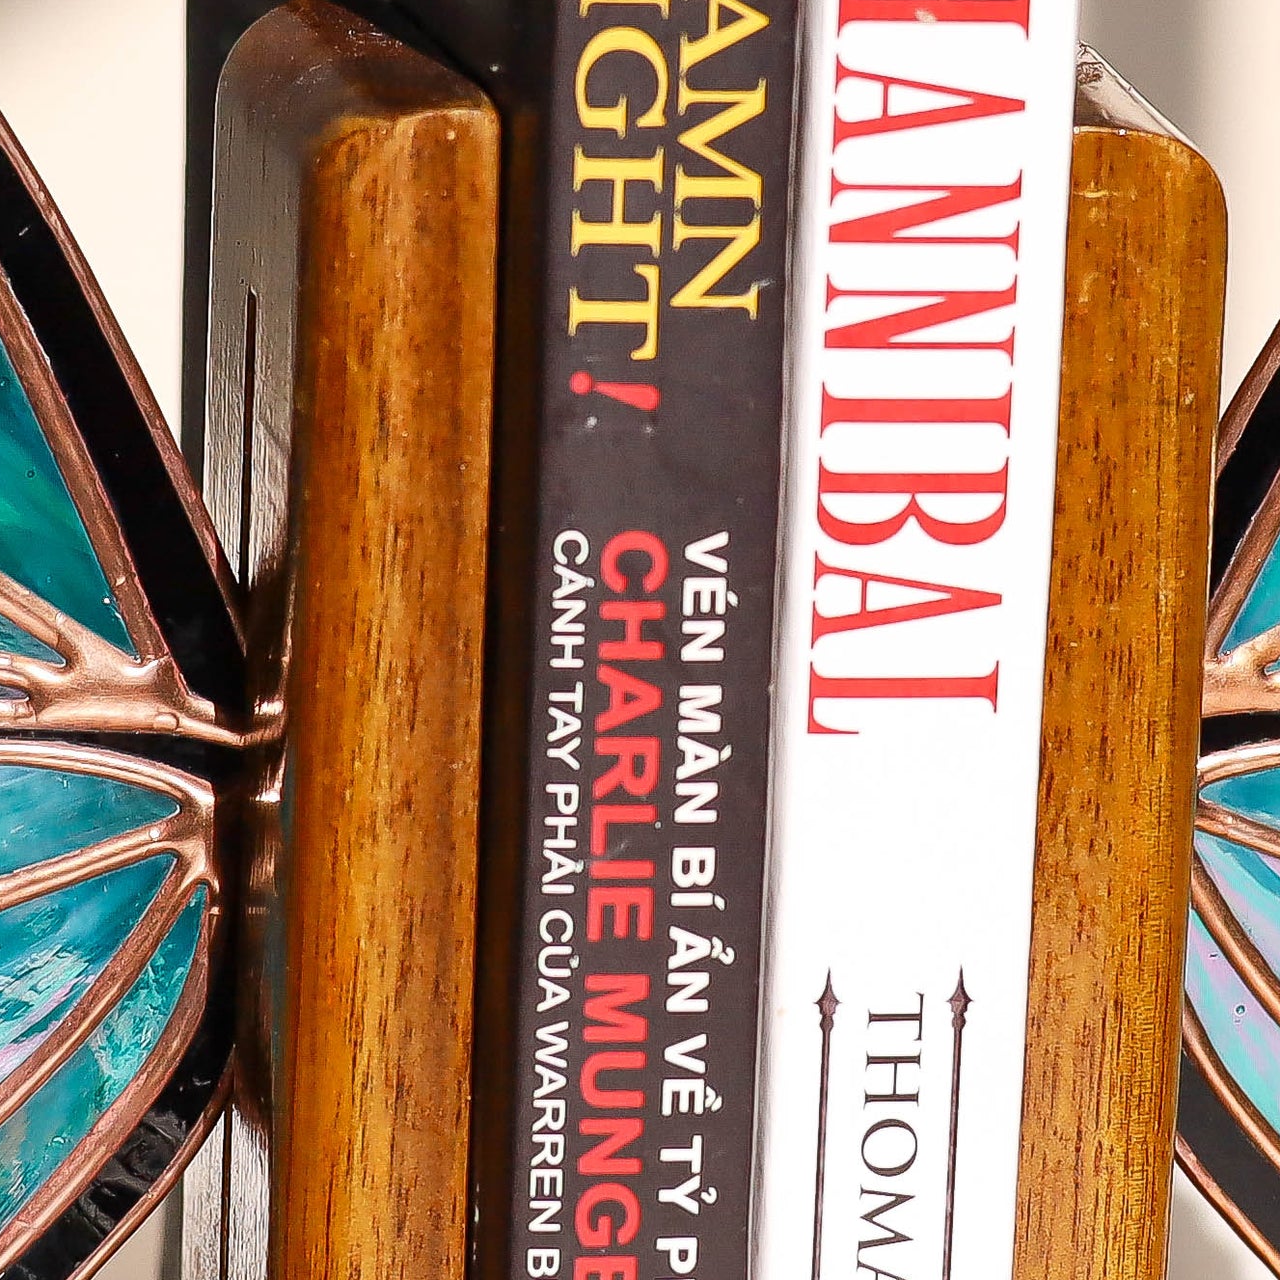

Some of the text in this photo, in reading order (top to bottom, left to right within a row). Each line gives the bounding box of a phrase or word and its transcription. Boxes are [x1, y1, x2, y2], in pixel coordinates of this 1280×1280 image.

[679, 531, 738, 662] VÉN
[545, 682, 585, 771] TAY
[586, 529, 670, 942] CHARLIE
[674, 683, 731, 824] MÀN
[539, 783, 585, 896] PHẢI
[669, 846, 725, 908] BÍ
[535, 907, 580, 1012] CỦA
[664, 925, 735, 1013] ẨN
[528, 1021, 570, 1234] WARREN
[660, 1033, 722, 1117] VỀ
[658, 1134, 719, 1216] TỶ
